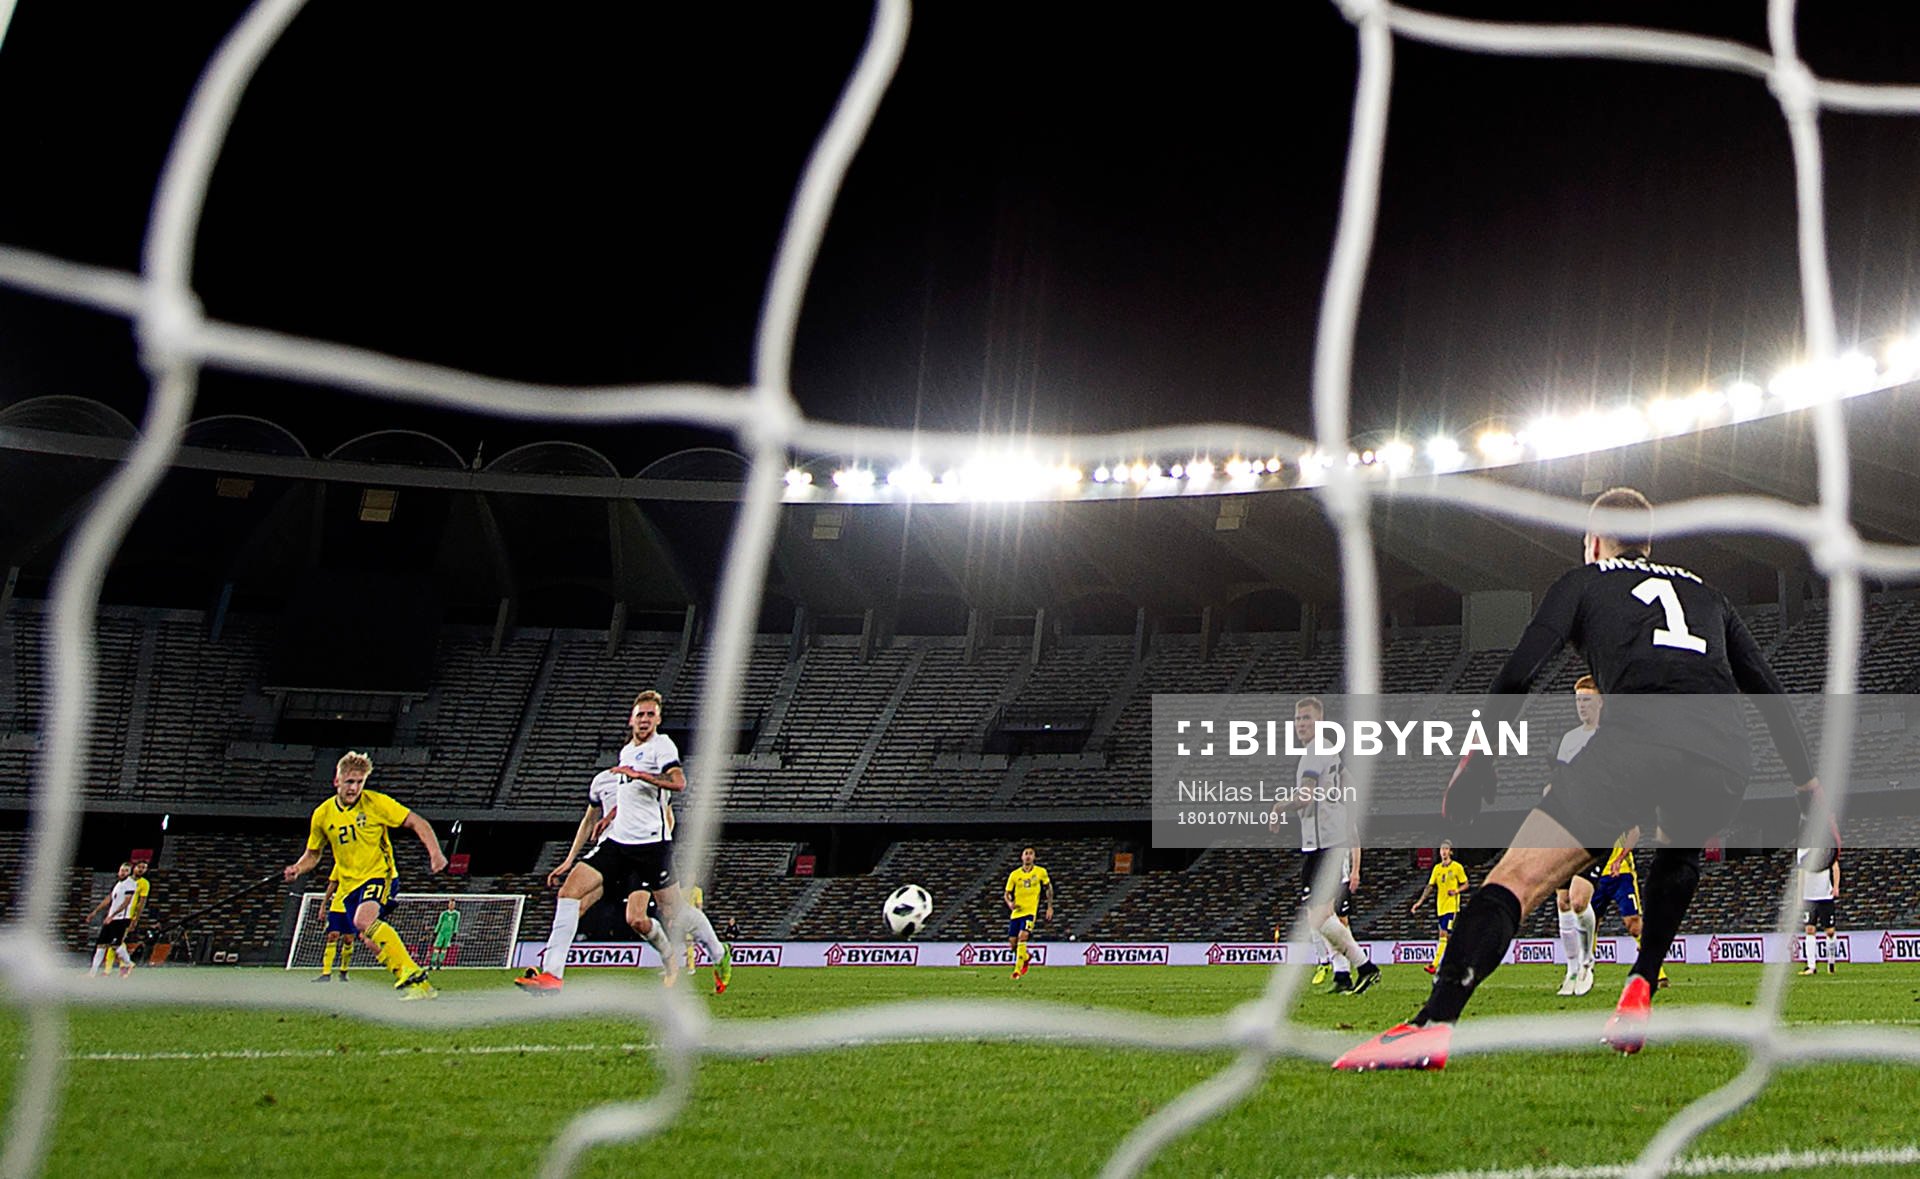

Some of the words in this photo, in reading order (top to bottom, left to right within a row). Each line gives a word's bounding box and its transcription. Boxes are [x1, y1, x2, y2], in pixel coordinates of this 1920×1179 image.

[1631, 577, 1707, 654] 1
[339, 824, 357, 845] 21
[363, 884, 383, 900] 21
[1226, 949, 1283, 961] BYGMA
[1404, 948, 1435, 960] BYGMA
[1522, 946, 1552, 959] BYGMA
[1721, 943, 1760, 958] BYGMA
[1897, 940, 1920, 958] BYG
[847, 950, 912, 962] BYGMA
[980, 950, 1041, 962] BYGA
[1104, 950, 1163, 962] BYGMA
